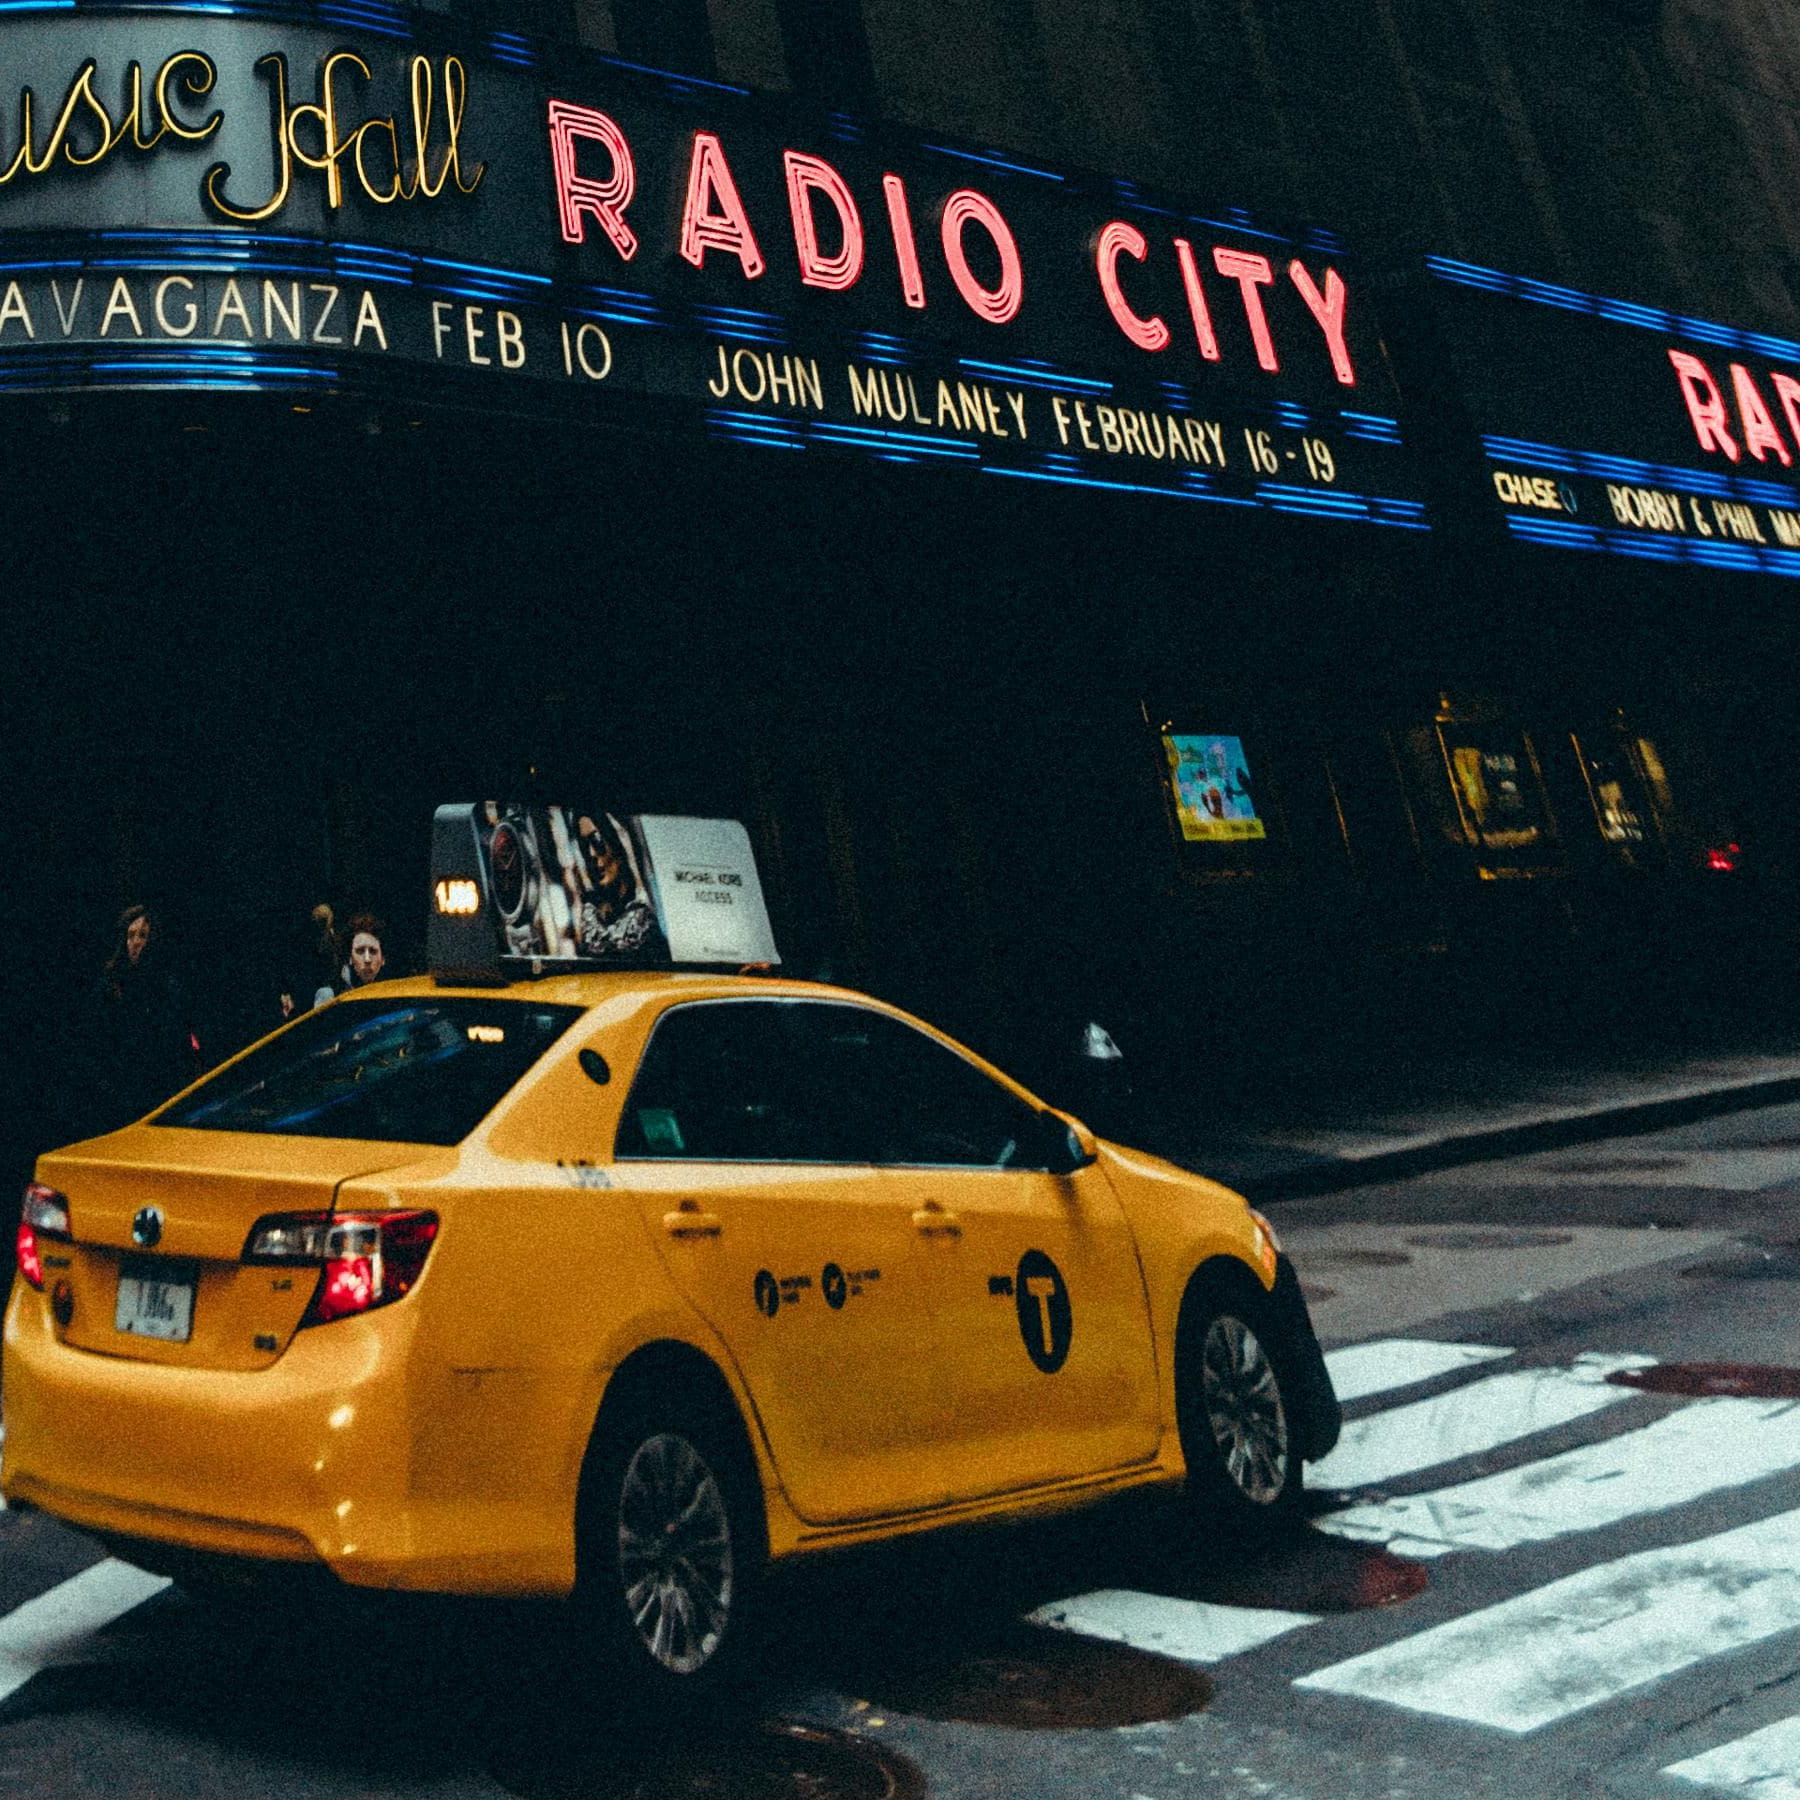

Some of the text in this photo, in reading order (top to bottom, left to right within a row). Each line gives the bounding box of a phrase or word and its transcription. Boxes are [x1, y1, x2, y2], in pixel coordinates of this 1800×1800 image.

[206, 52, 486, 221] Hall
[548, 98, 1356, 387] RADIO CITY
[431, 301, 527, 369] FEB
[560, 321, 613, 380] 10
[707, 344, 825, 411] JOHN
[846, 363, 1029, 440] MULANEY
[1051, 396, 1228, 469] FEBRUARY
[1492, 470, 1563, 511] CHASE
[1607, 484, 1686, 532] BOBBY
[1690, 496, 1713, 537] &
[1711, 500, 1767, 545] PHIL
